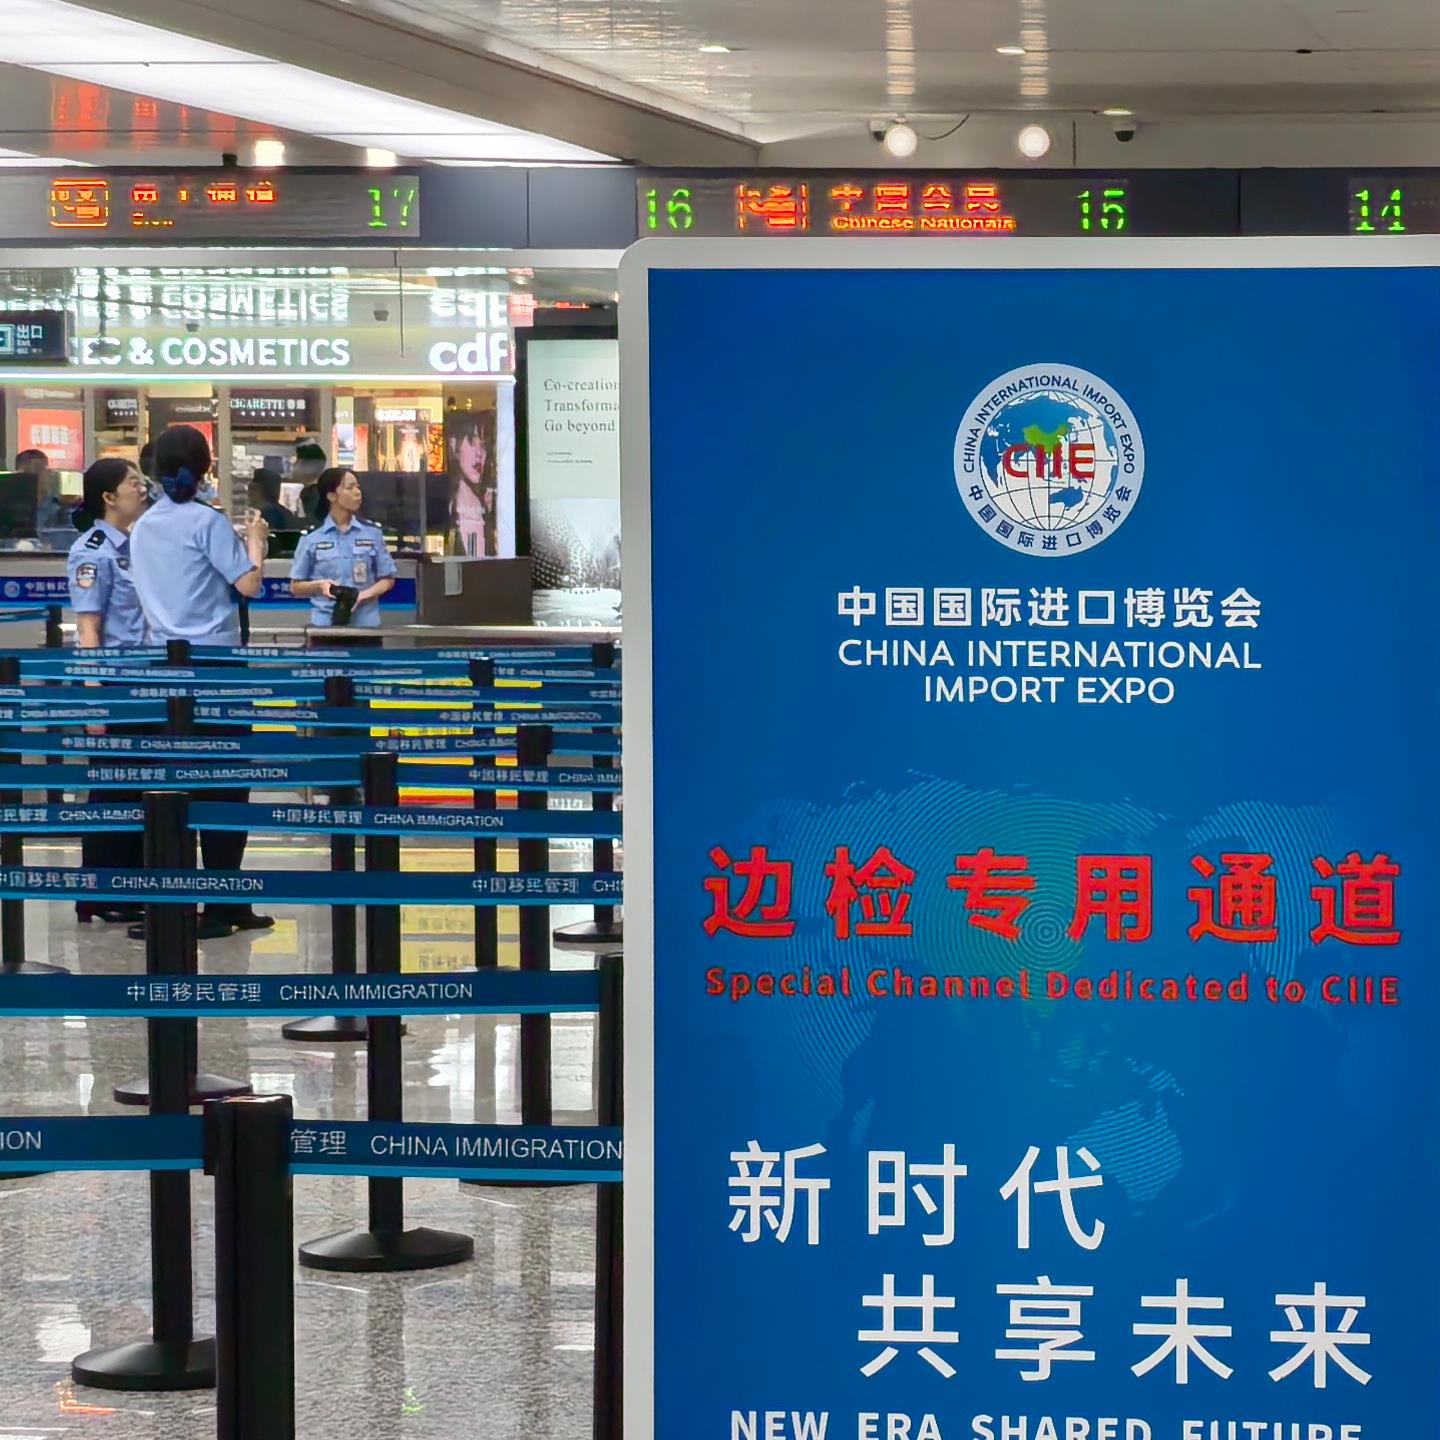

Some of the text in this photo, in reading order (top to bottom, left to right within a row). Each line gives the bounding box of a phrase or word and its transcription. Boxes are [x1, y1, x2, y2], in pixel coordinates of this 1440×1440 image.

[367, 189, 414, 227] 17
[646, 188, 693, 230] 16
[1079, 190, 1126, 229] 15
[1355, 189, 1406, 231] 14
[17, 324, 43, 339] 出口
[162, 337, 349, 366] COSMETICS
[430, 332, 508, 372] cdf
[567, 420, 615, 435] beyond
[964, 375, 1135, 474] CHINA INTERNATIONAL IMPORT EXPO
[1003, 443, 1095, 479] CIIE
[968, 485, 1132, 550] 中国国际进口博览会
[838, 586, 1262, 628] 中国国际进口博览会
[838, 639, 1262, 669] CHINA INTERNATIONAL
[925, 676, 1175, 704] IMPORT EXPO
[59, 811, 100, 820] CHINA
[272, 809, 503, 826] 中国移民管理 CHINA IMMIGRATION
[112, 876, 158, 888] CHINA
[162, 878, 263, 890] IMMIGRATION
[473, 878, 578, 893] 中国移民管理
[702, 845, 1403, 946] 边检专用通道
[127, 983, 472, 1001] 中国移民管理 CHINA IMMIGRATION
[706, 967, 1400, 1005] Special Channel Dedicated to CIIE
[371, 1136, 448, 1155] CHINA
[456, 1138, 624, 1159] IMMIGRATION
[729, 1139, 1106, 1251] 新时代
[857, 1274, 1372, 1389] 共享未来
